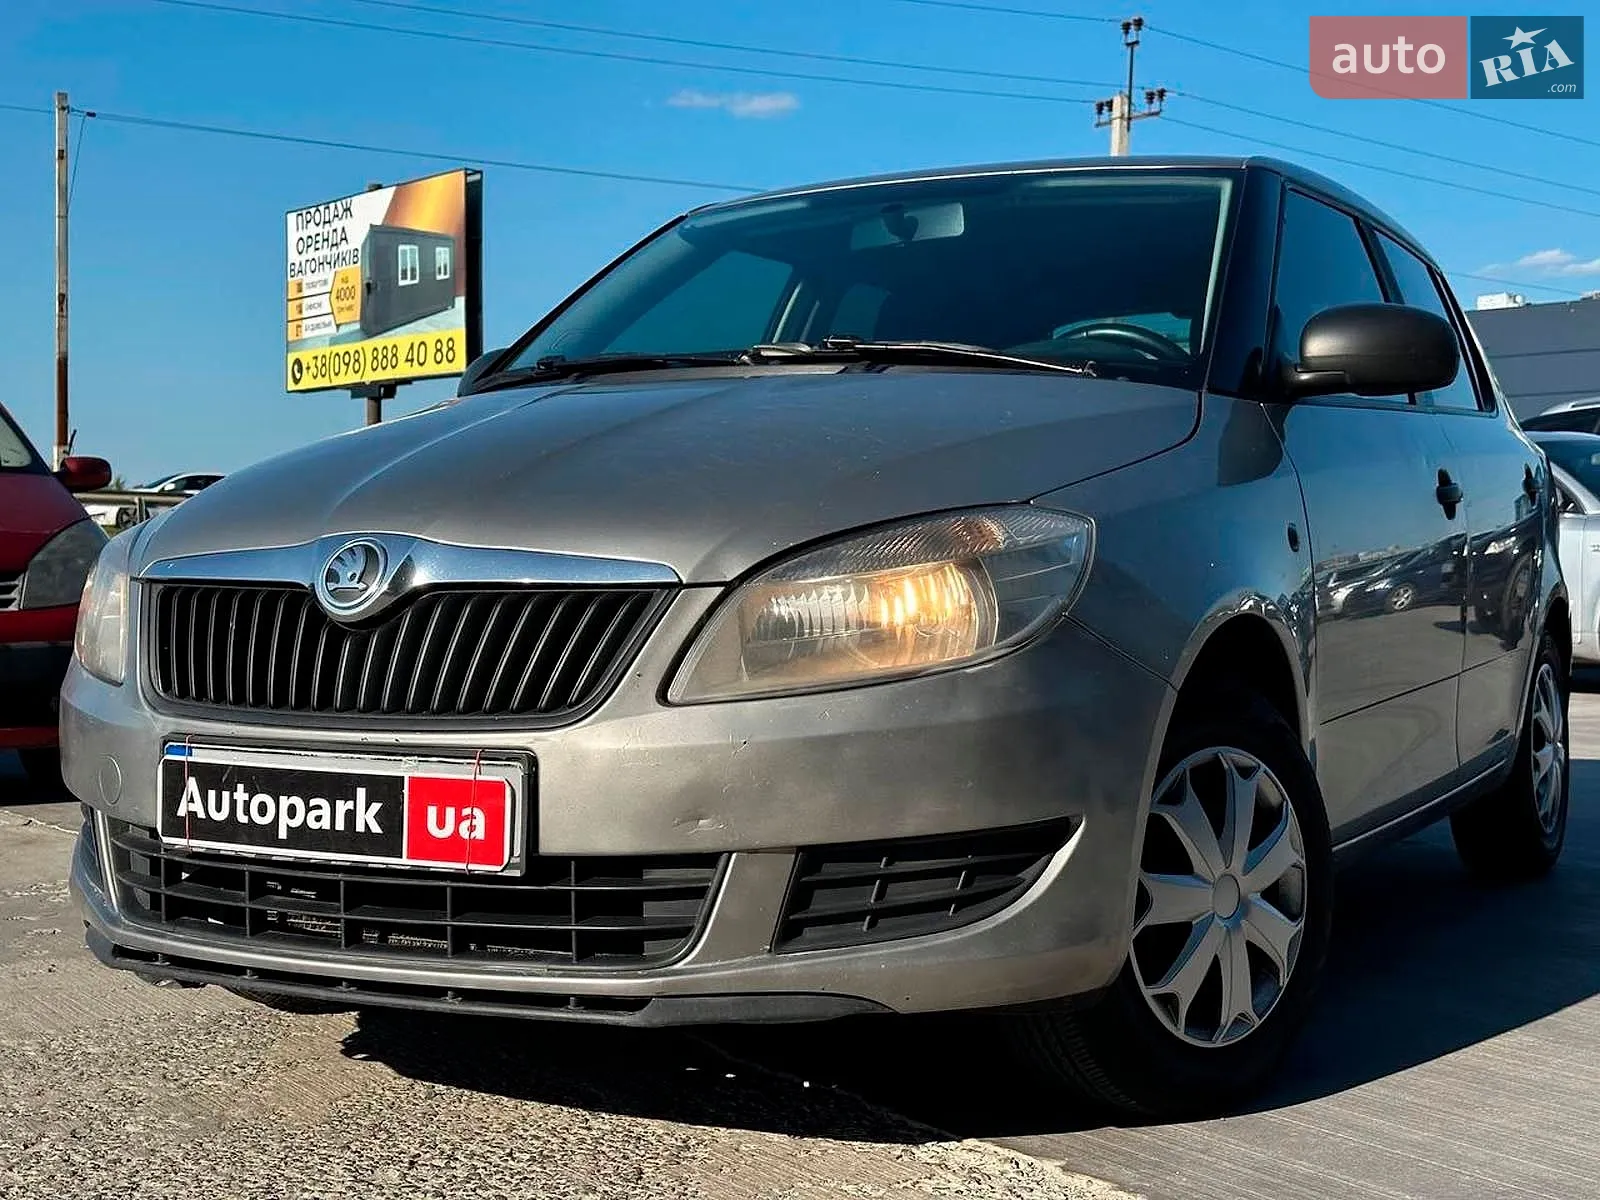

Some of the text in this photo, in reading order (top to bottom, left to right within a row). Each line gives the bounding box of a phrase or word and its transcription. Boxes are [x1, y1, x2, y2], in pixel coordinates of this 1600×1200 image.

[295, 199, 353, 232] ПРОДАЖ
[296, 226, 349, 255] ОРЕНДА
[289, 248, 360, 278] ВАГОНЧИКІВ
[336, 285, 356, 302] 4000
[305, 337, 456, 383] +38(098) 888 40 88
[176, 776, 486, 841] Autopark ua
